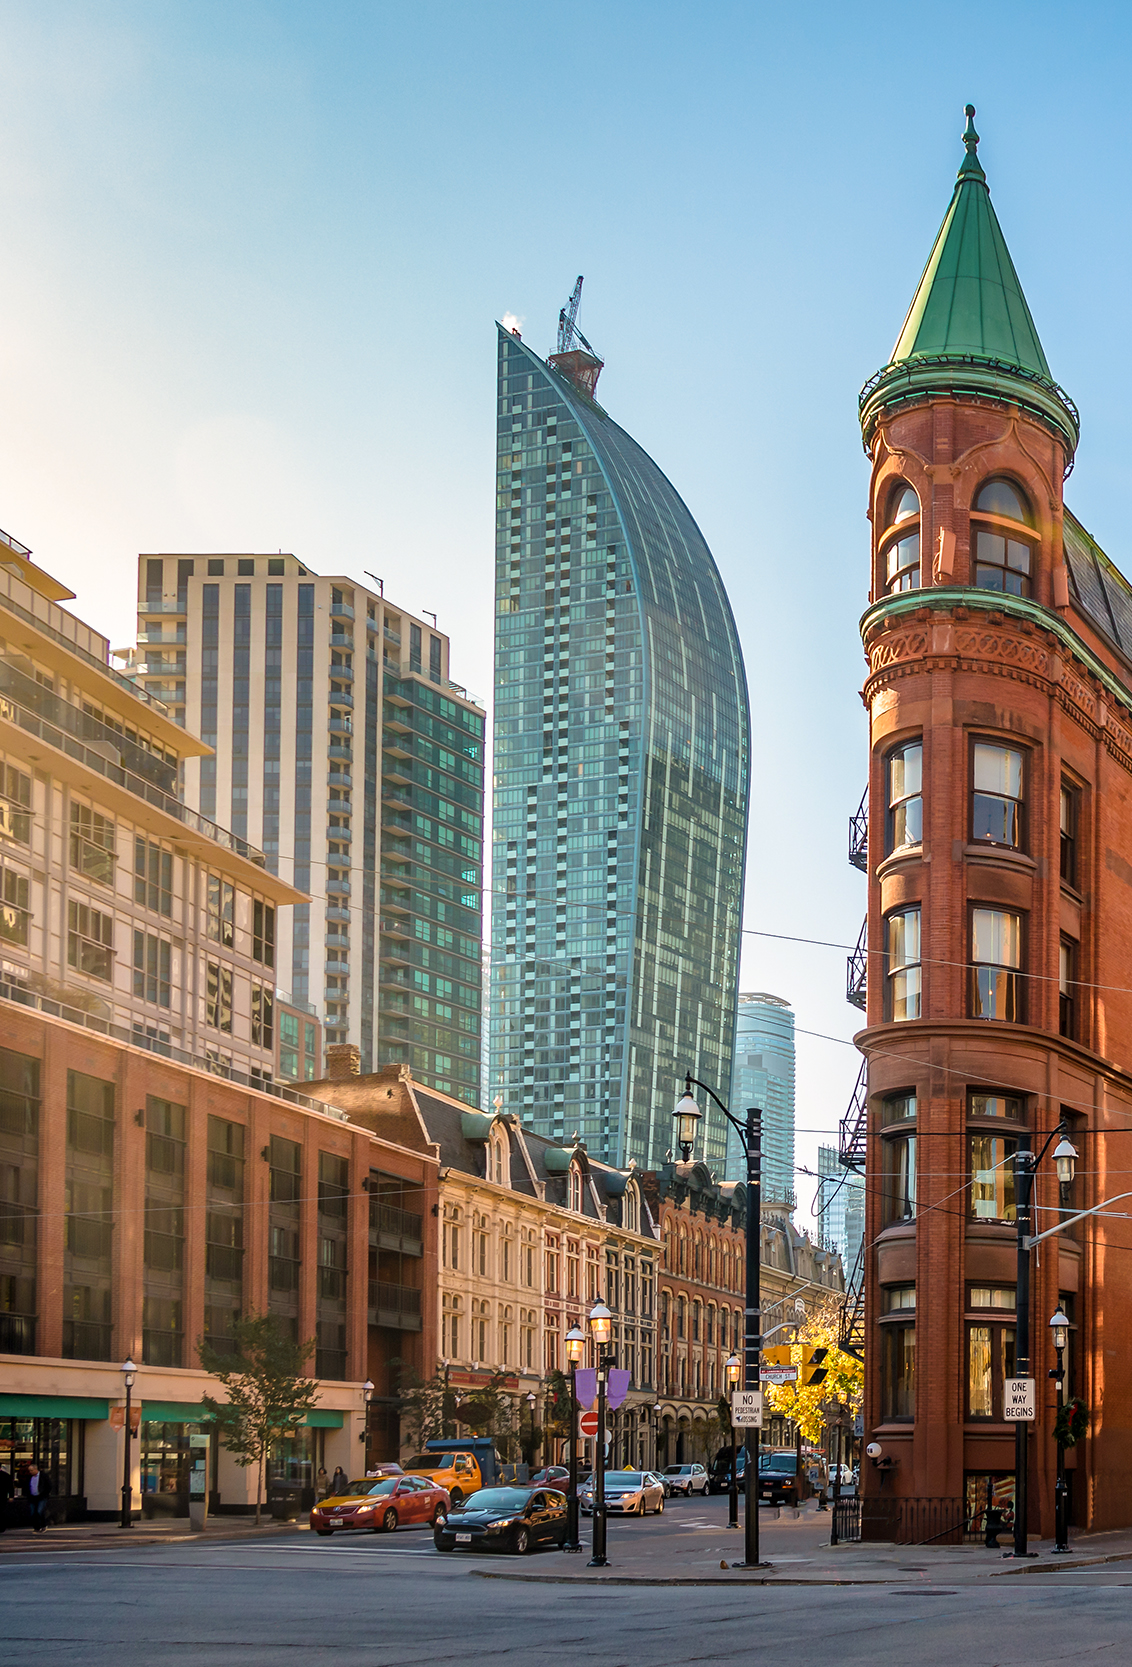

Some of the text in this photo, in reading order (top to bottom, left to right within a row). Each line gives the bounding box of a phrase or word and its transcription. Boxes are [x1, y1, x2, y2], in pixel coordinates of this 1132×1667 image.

[1012, 1382, 1027, 1392] ONE
[742, 1395, 753, 1405] NO
[1011, 1395, 1027, 1404] WAY
[1005, 1407, 1033, 1417] BEGINS
